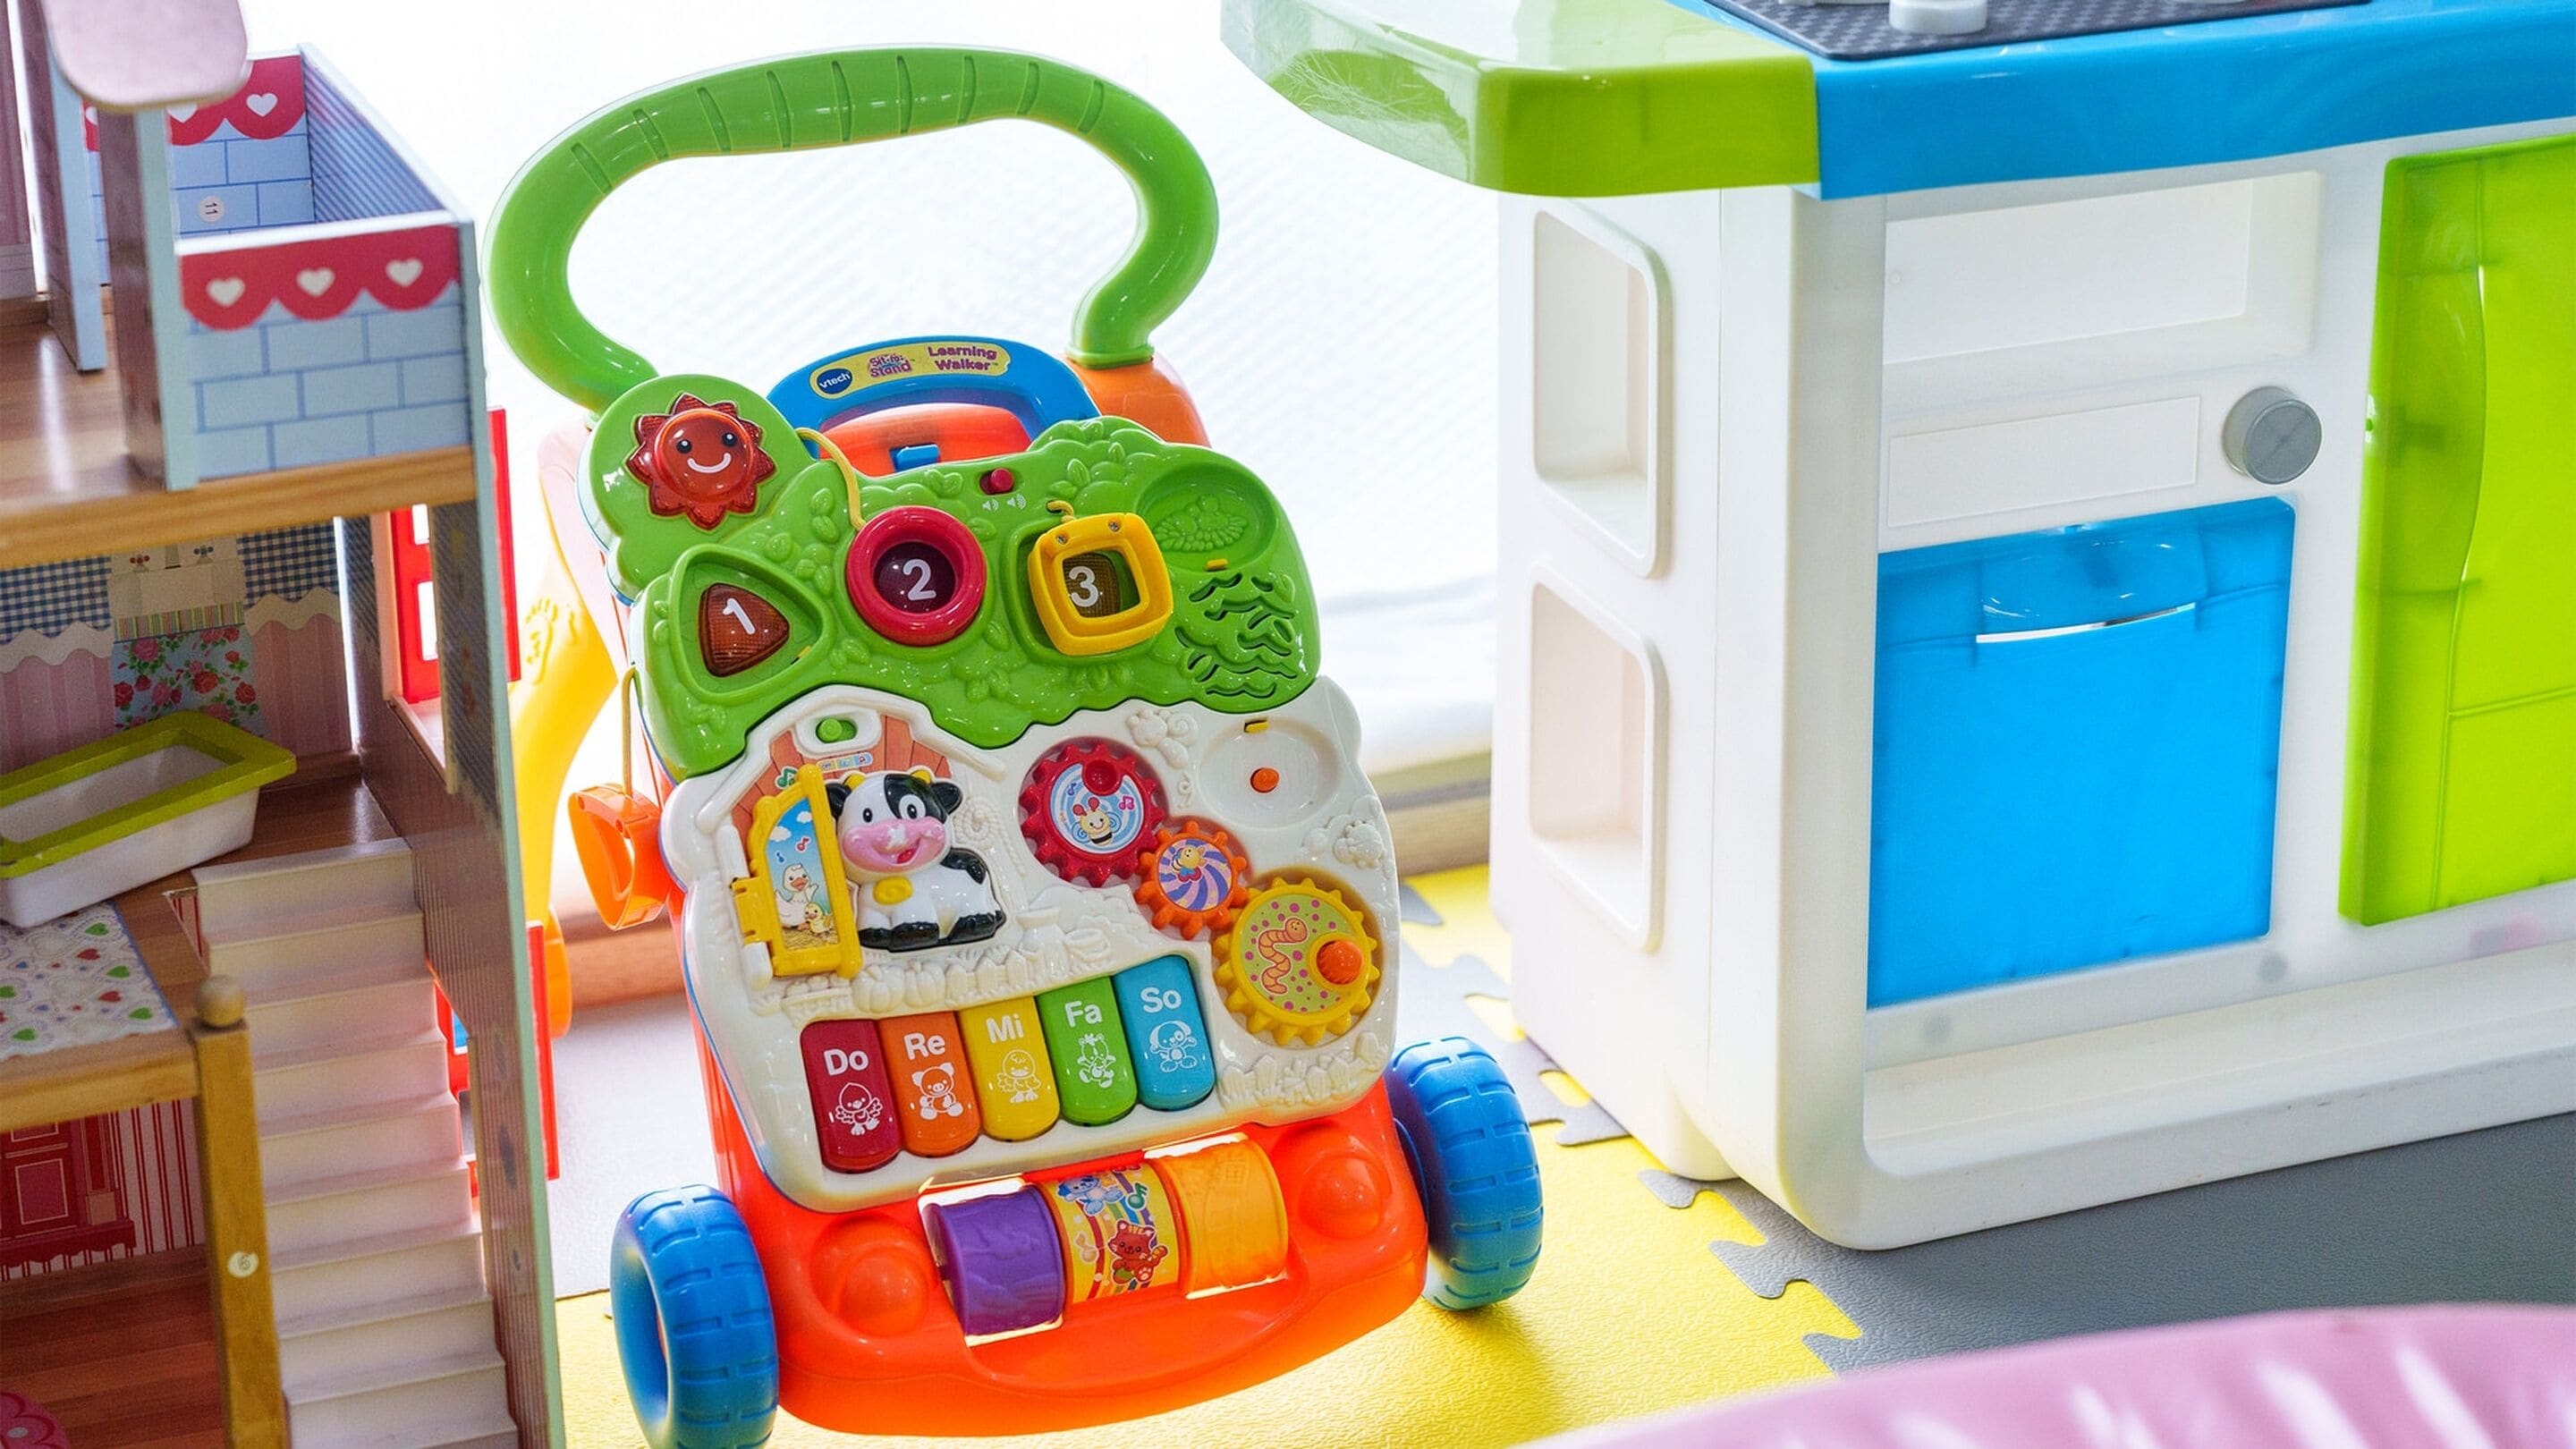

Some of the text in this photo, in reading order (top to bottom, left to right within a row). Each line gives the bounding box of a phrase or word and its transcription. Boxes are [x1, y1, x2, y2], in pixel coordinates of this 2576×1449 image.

[927, 345, 997, 360] Learning
[934, 358, 990, 371] Walker
[819, 372, 852, 388] vtech
[869, 360, 912, 377] Stand
[902, 558, 937, 601] 2
[1068, 565, 1098, 607] 3
[722, 597, 757, 635] 1
[823, 987, 1182, 1076] Do Re Mi Fa So
